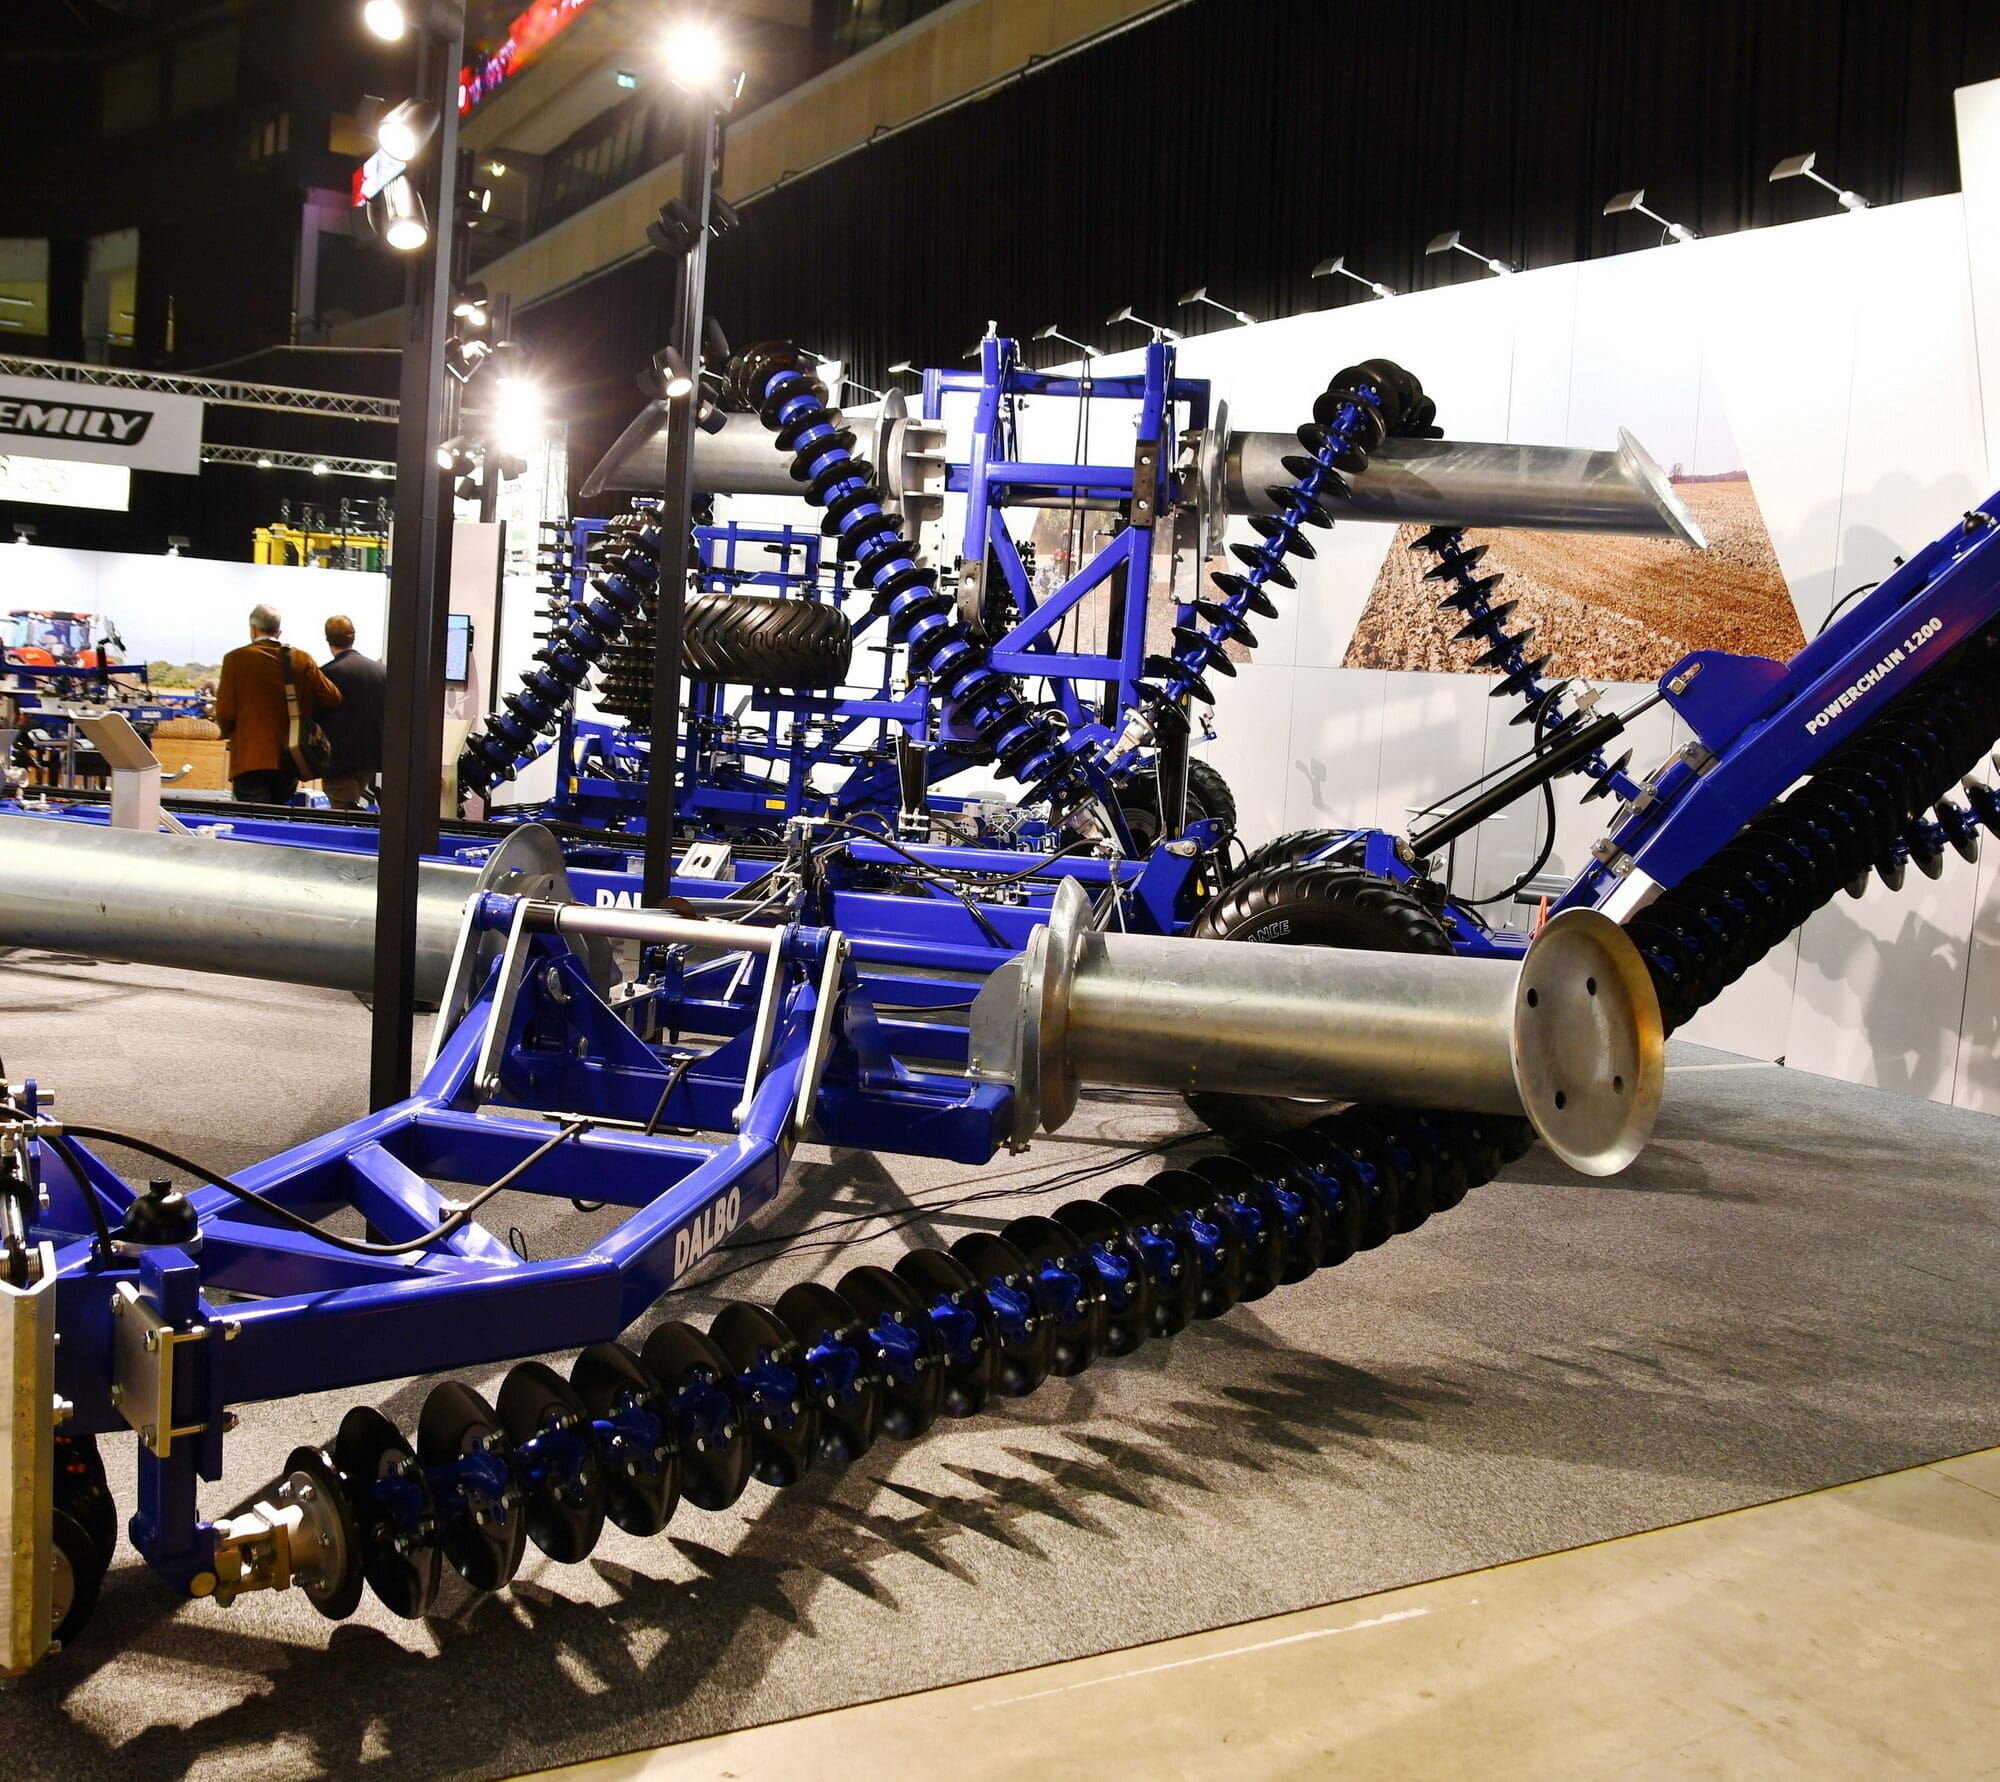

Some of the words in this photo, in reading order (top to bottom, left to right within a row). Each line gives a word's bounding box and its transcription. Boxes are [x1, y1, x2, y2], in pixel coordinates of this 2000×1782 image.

[0, 401, 143, 440] EMILY
[1805, 648, 1906, 736] POWERCHAIN
[1903, 617, 1943, 654] 1200
[674, 1186, 740, 1280] DALBO
